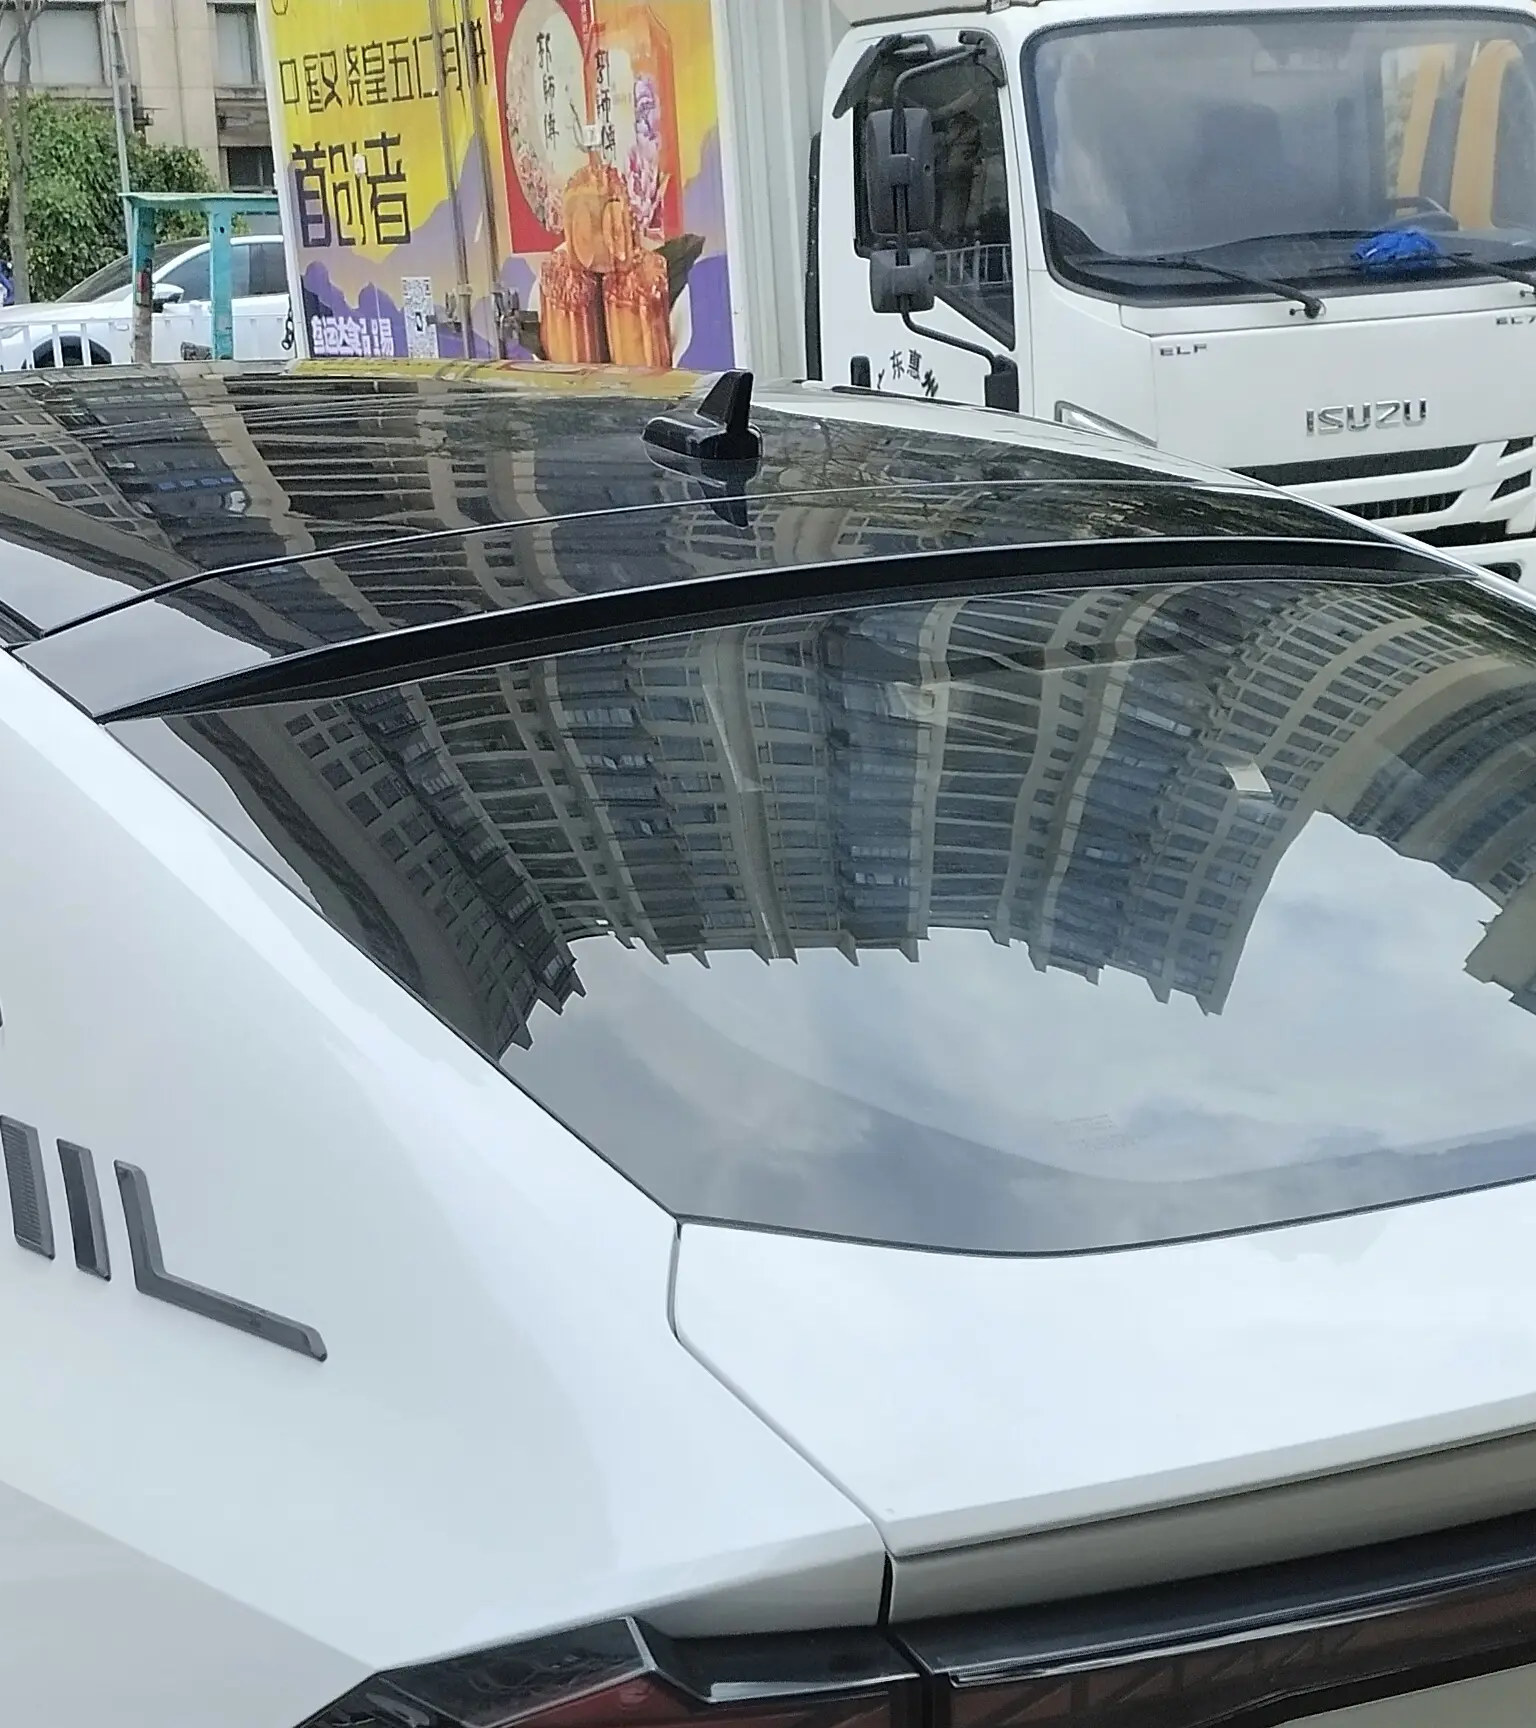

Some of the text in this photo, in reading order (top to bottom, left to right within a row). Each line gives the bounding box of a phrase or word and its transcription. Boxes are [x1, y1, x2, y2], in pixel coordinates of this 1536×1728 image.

[292, 131, 411, 248] 首创者
[1159, 343, 1207, 357] ELF
[1305, 398, 1427, 437] ISUZU
